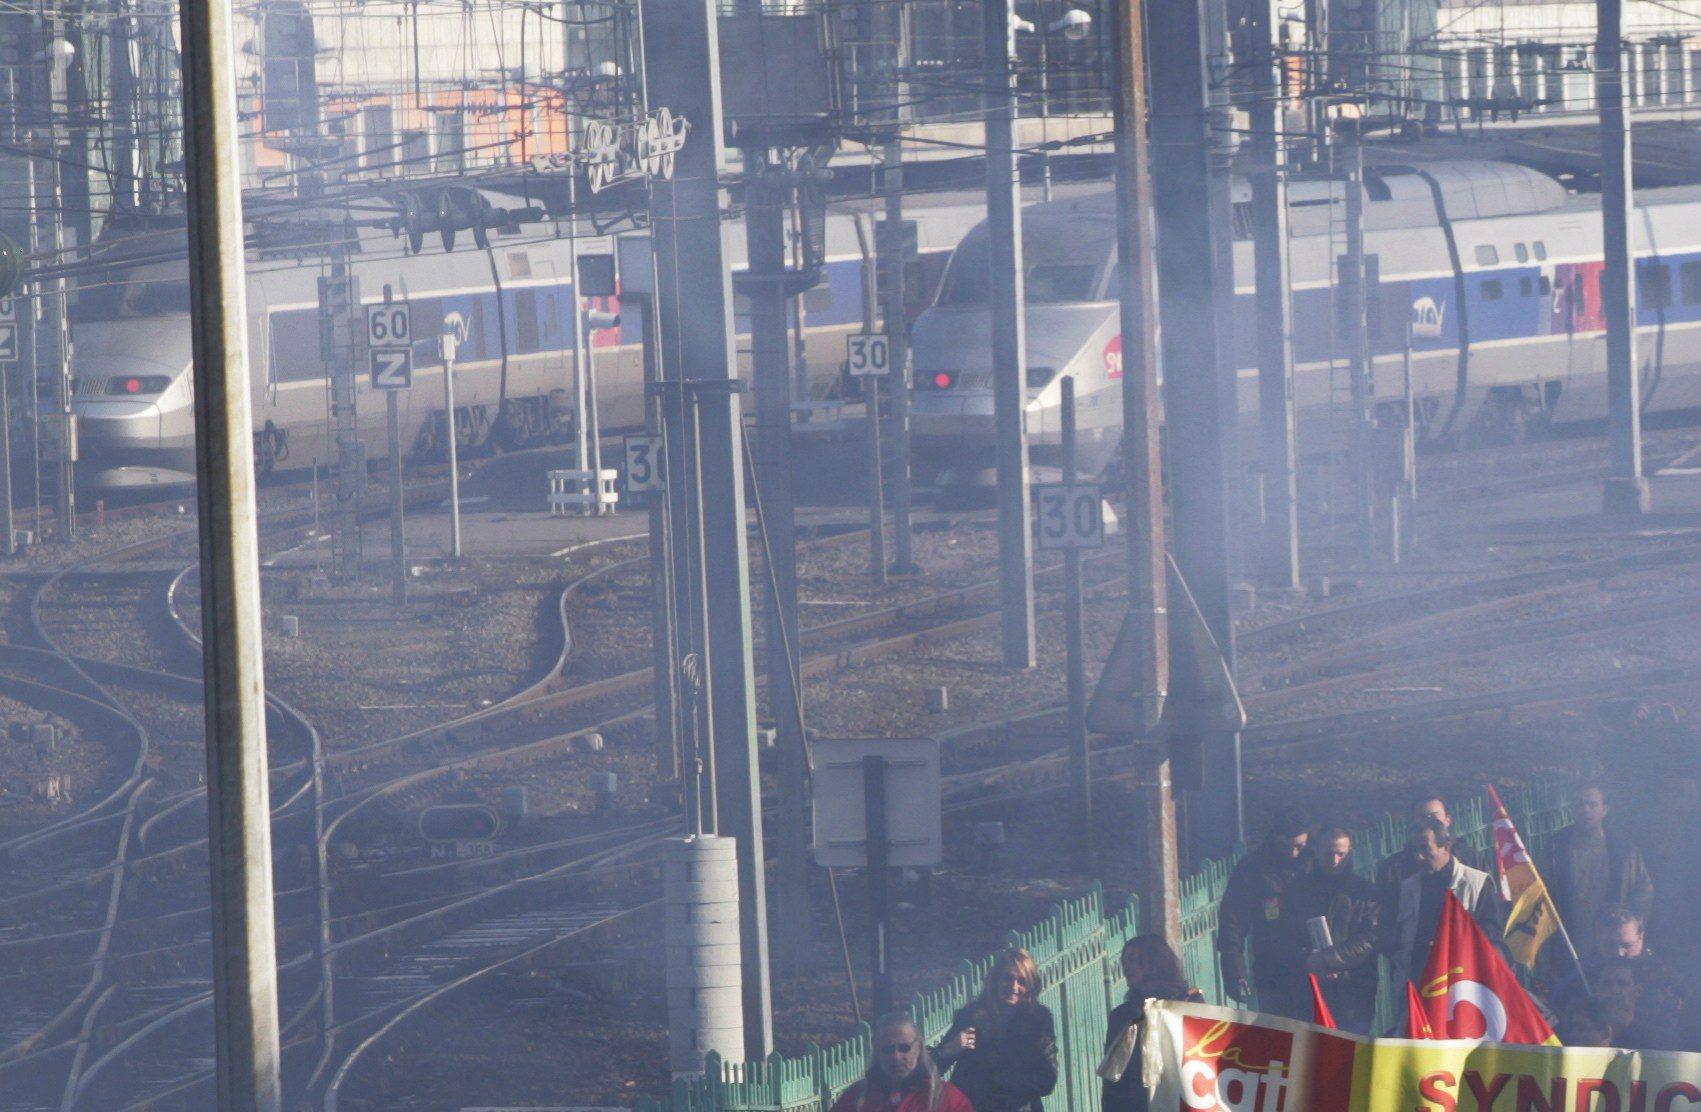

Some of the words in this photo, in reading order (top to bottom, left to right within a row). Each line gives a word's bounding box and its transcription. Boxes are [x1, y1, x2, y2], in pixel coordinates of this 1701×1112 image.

[371, 310, 408, 340] 60
[376, 353, 406, 386] Z
[851, 341, 887, 370] 30
[1042, 494, 1098, 539] 30
